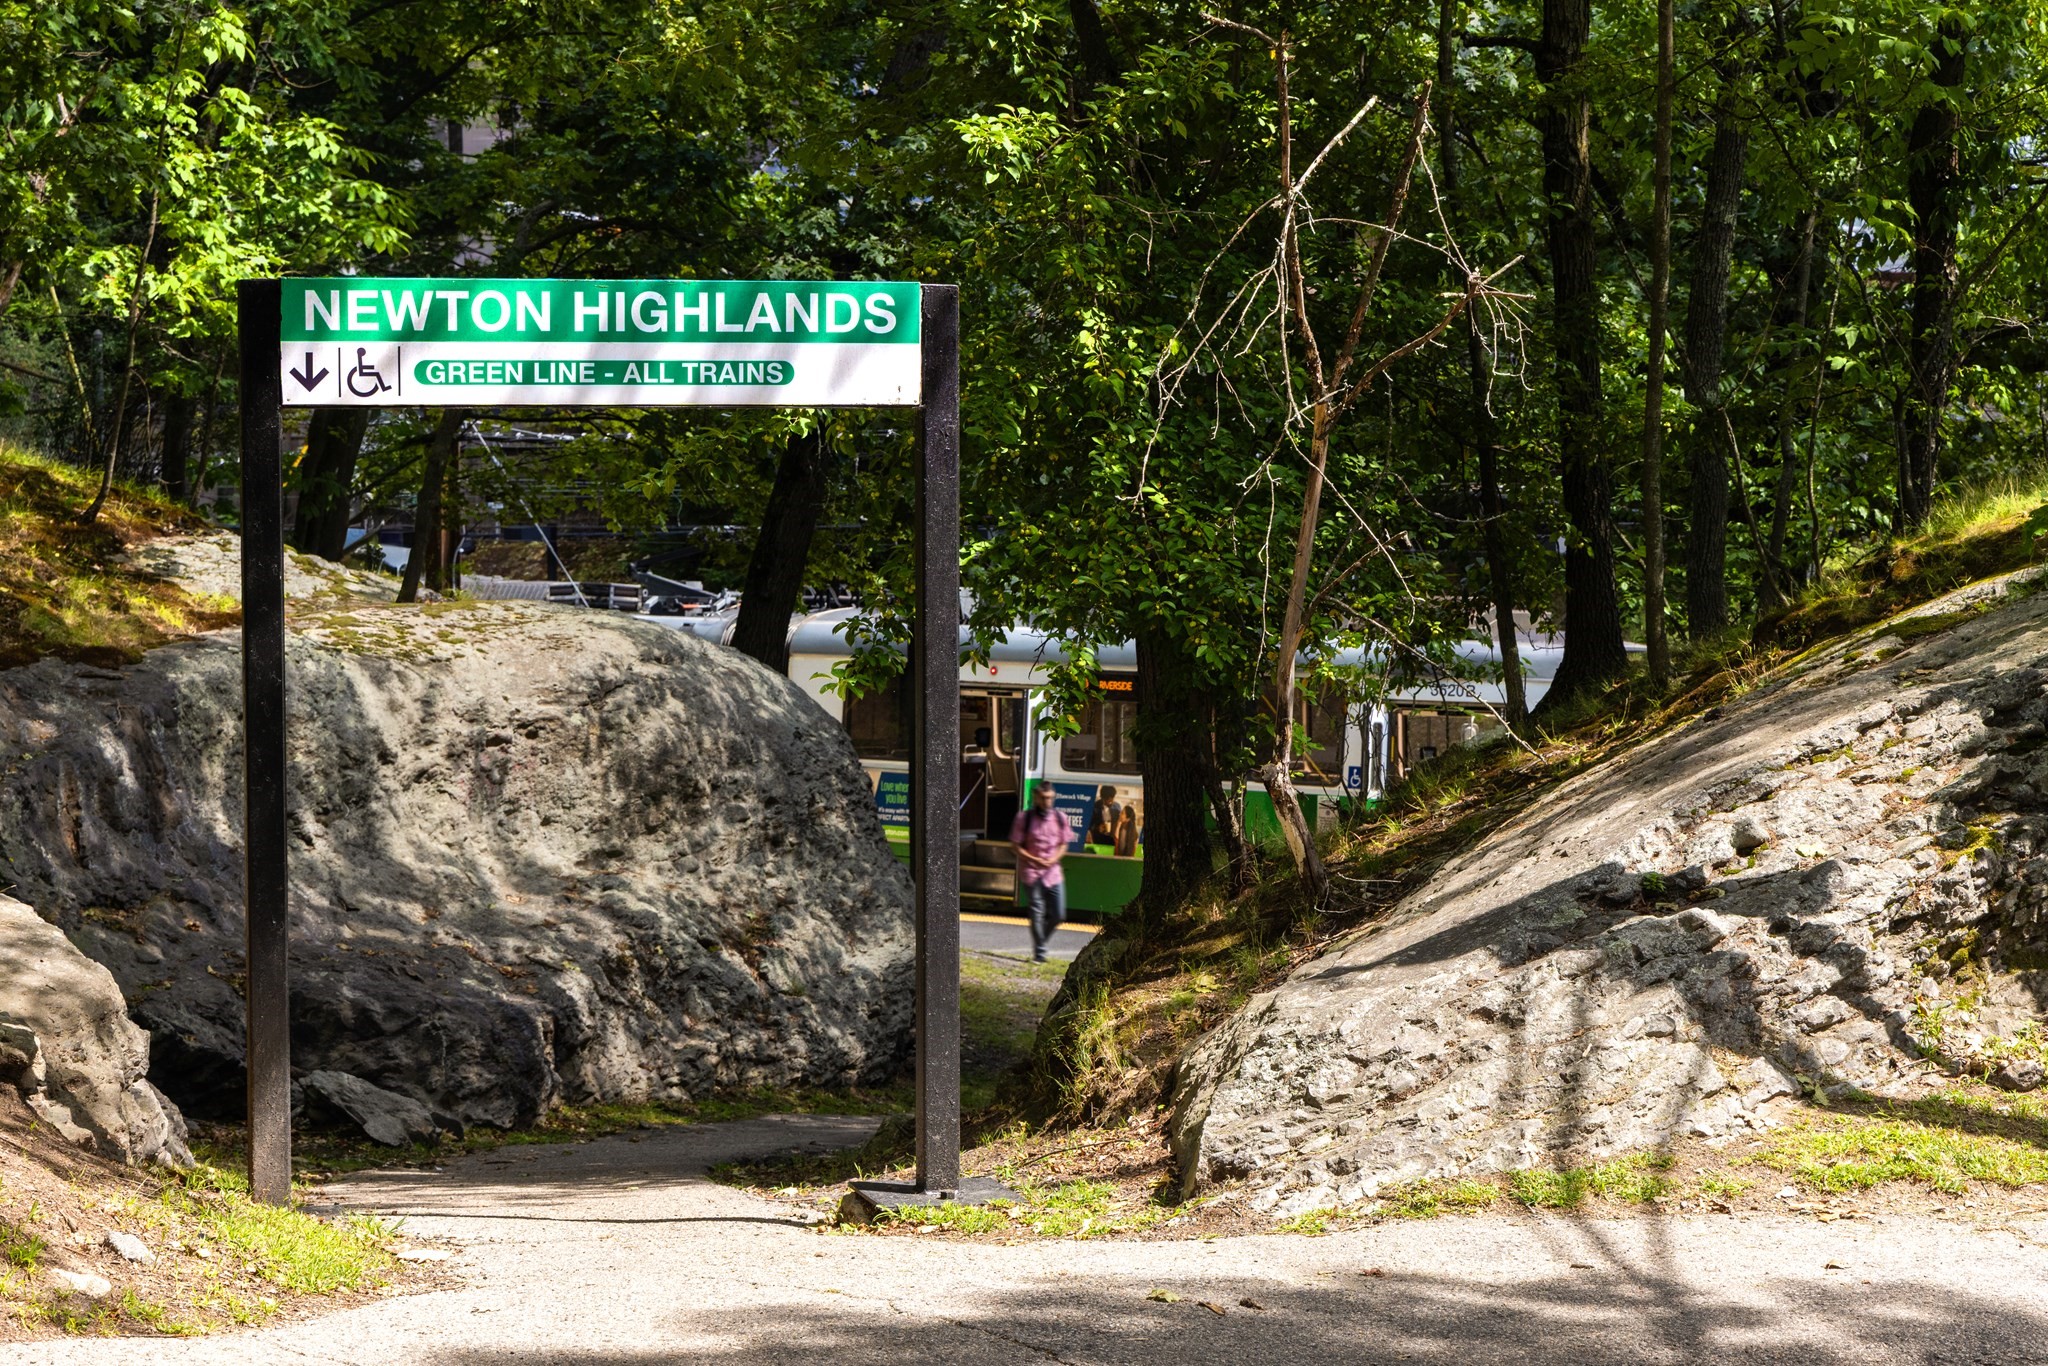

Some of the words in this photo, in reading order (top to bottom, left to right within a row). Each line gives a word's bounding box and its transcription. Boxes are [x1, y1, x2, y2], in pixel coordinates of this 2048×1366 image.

[304, 289, 551, 333] NEWTON
[573, 290, 897, 334] HIGHLANDS
[425, 361, 523, 384] GREEN
[534, 361, 596, 384] LINE
[622, 362, 675, 384] ALL
[681, 362, 784, 384] TRAINS
[1099, 680, 1133, 691] RIVERSIDE
[880, 781, 894, 792] Love
[885, 794, 897, 805] you
[897, 794, 908, 805] live
[1076, 793, 1092, 802] Village
